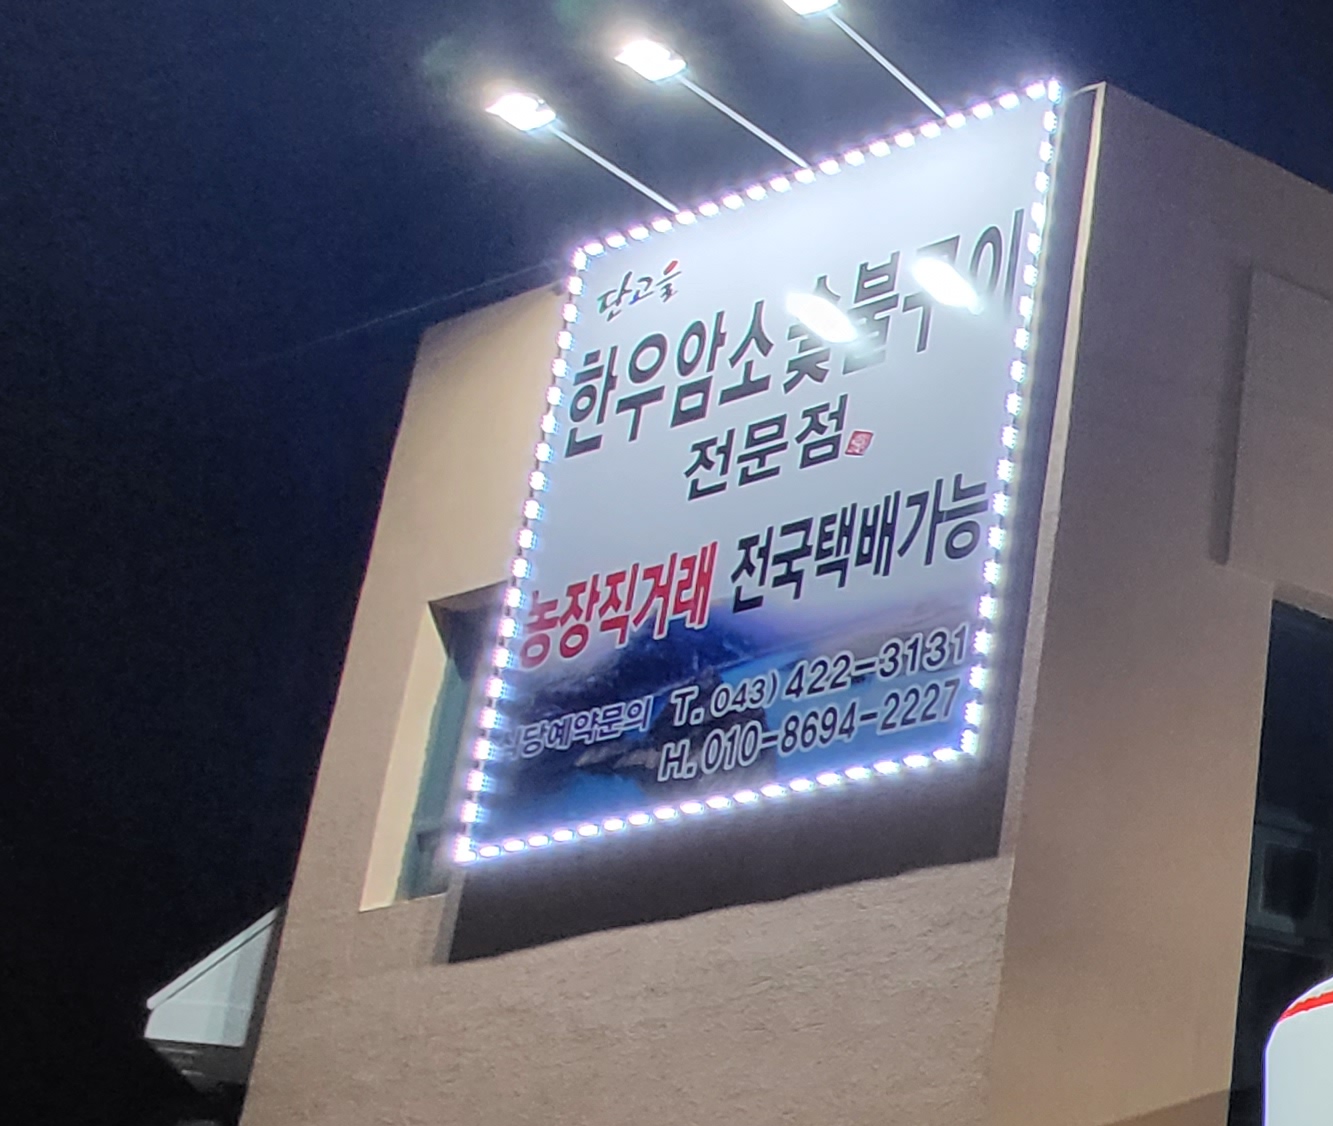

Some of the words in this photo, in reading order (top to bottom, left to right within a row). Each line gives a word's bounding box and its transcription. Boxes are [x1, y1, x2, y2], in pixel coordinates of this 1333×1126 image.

[597, 259, 683, 323] 단고을
[683, 393, 849, 502] 전문점
[520, 539, 719, 668] 농장직거래
[730, 472, 989, 615] 전국택배가능
